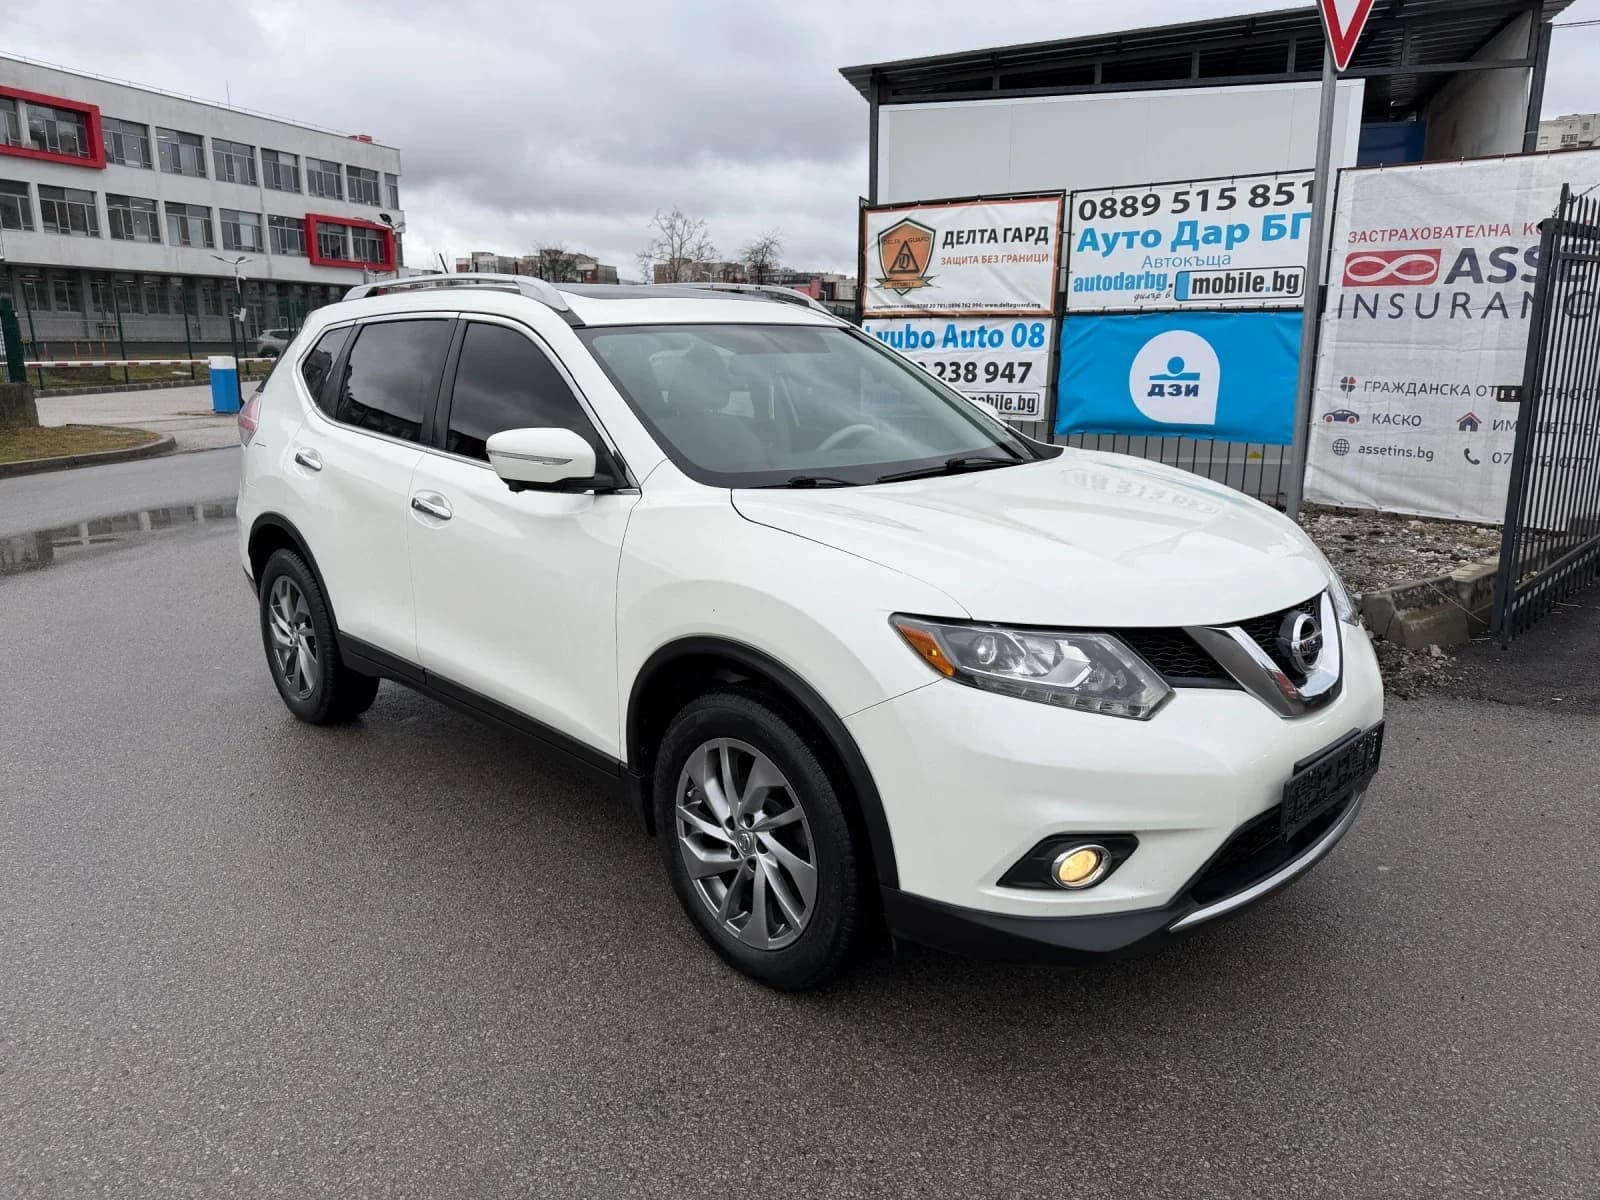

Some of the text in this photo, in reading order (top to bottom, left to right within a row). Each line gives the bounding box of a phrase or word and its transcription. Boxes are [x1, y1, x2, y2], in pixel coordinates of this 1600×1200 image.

[1079, 179, 1315, 221] 0889 515 851
[942, 226, 1049, 249] ДЕЛТА ГАРД
[1076, 212, 1312, 257] Ауто Дар БГ
[1348, 223, 1511, 244] ЗАСТРАХОВАТЕЛНА
[940, 252, 1049, 266] ЗАЩИТА БЕЗ ГРАНИЦИ
[1141, 253, 1232, 269] Автокъща
[1191, 271, 1300, 295] mobile.bg
[941, 323, 1004, 348] Auto
[1011, 322, 1045, 348] 08
[934, 361, 978, 383] 238
[984, 361, 1033, 383] 947
[1364, 381, 1471, 398] ГРАЖДАНСКА
[1372, 413, 1422, 427] КАСКО
[1358, 443, 1434, 462] assetins.bg
